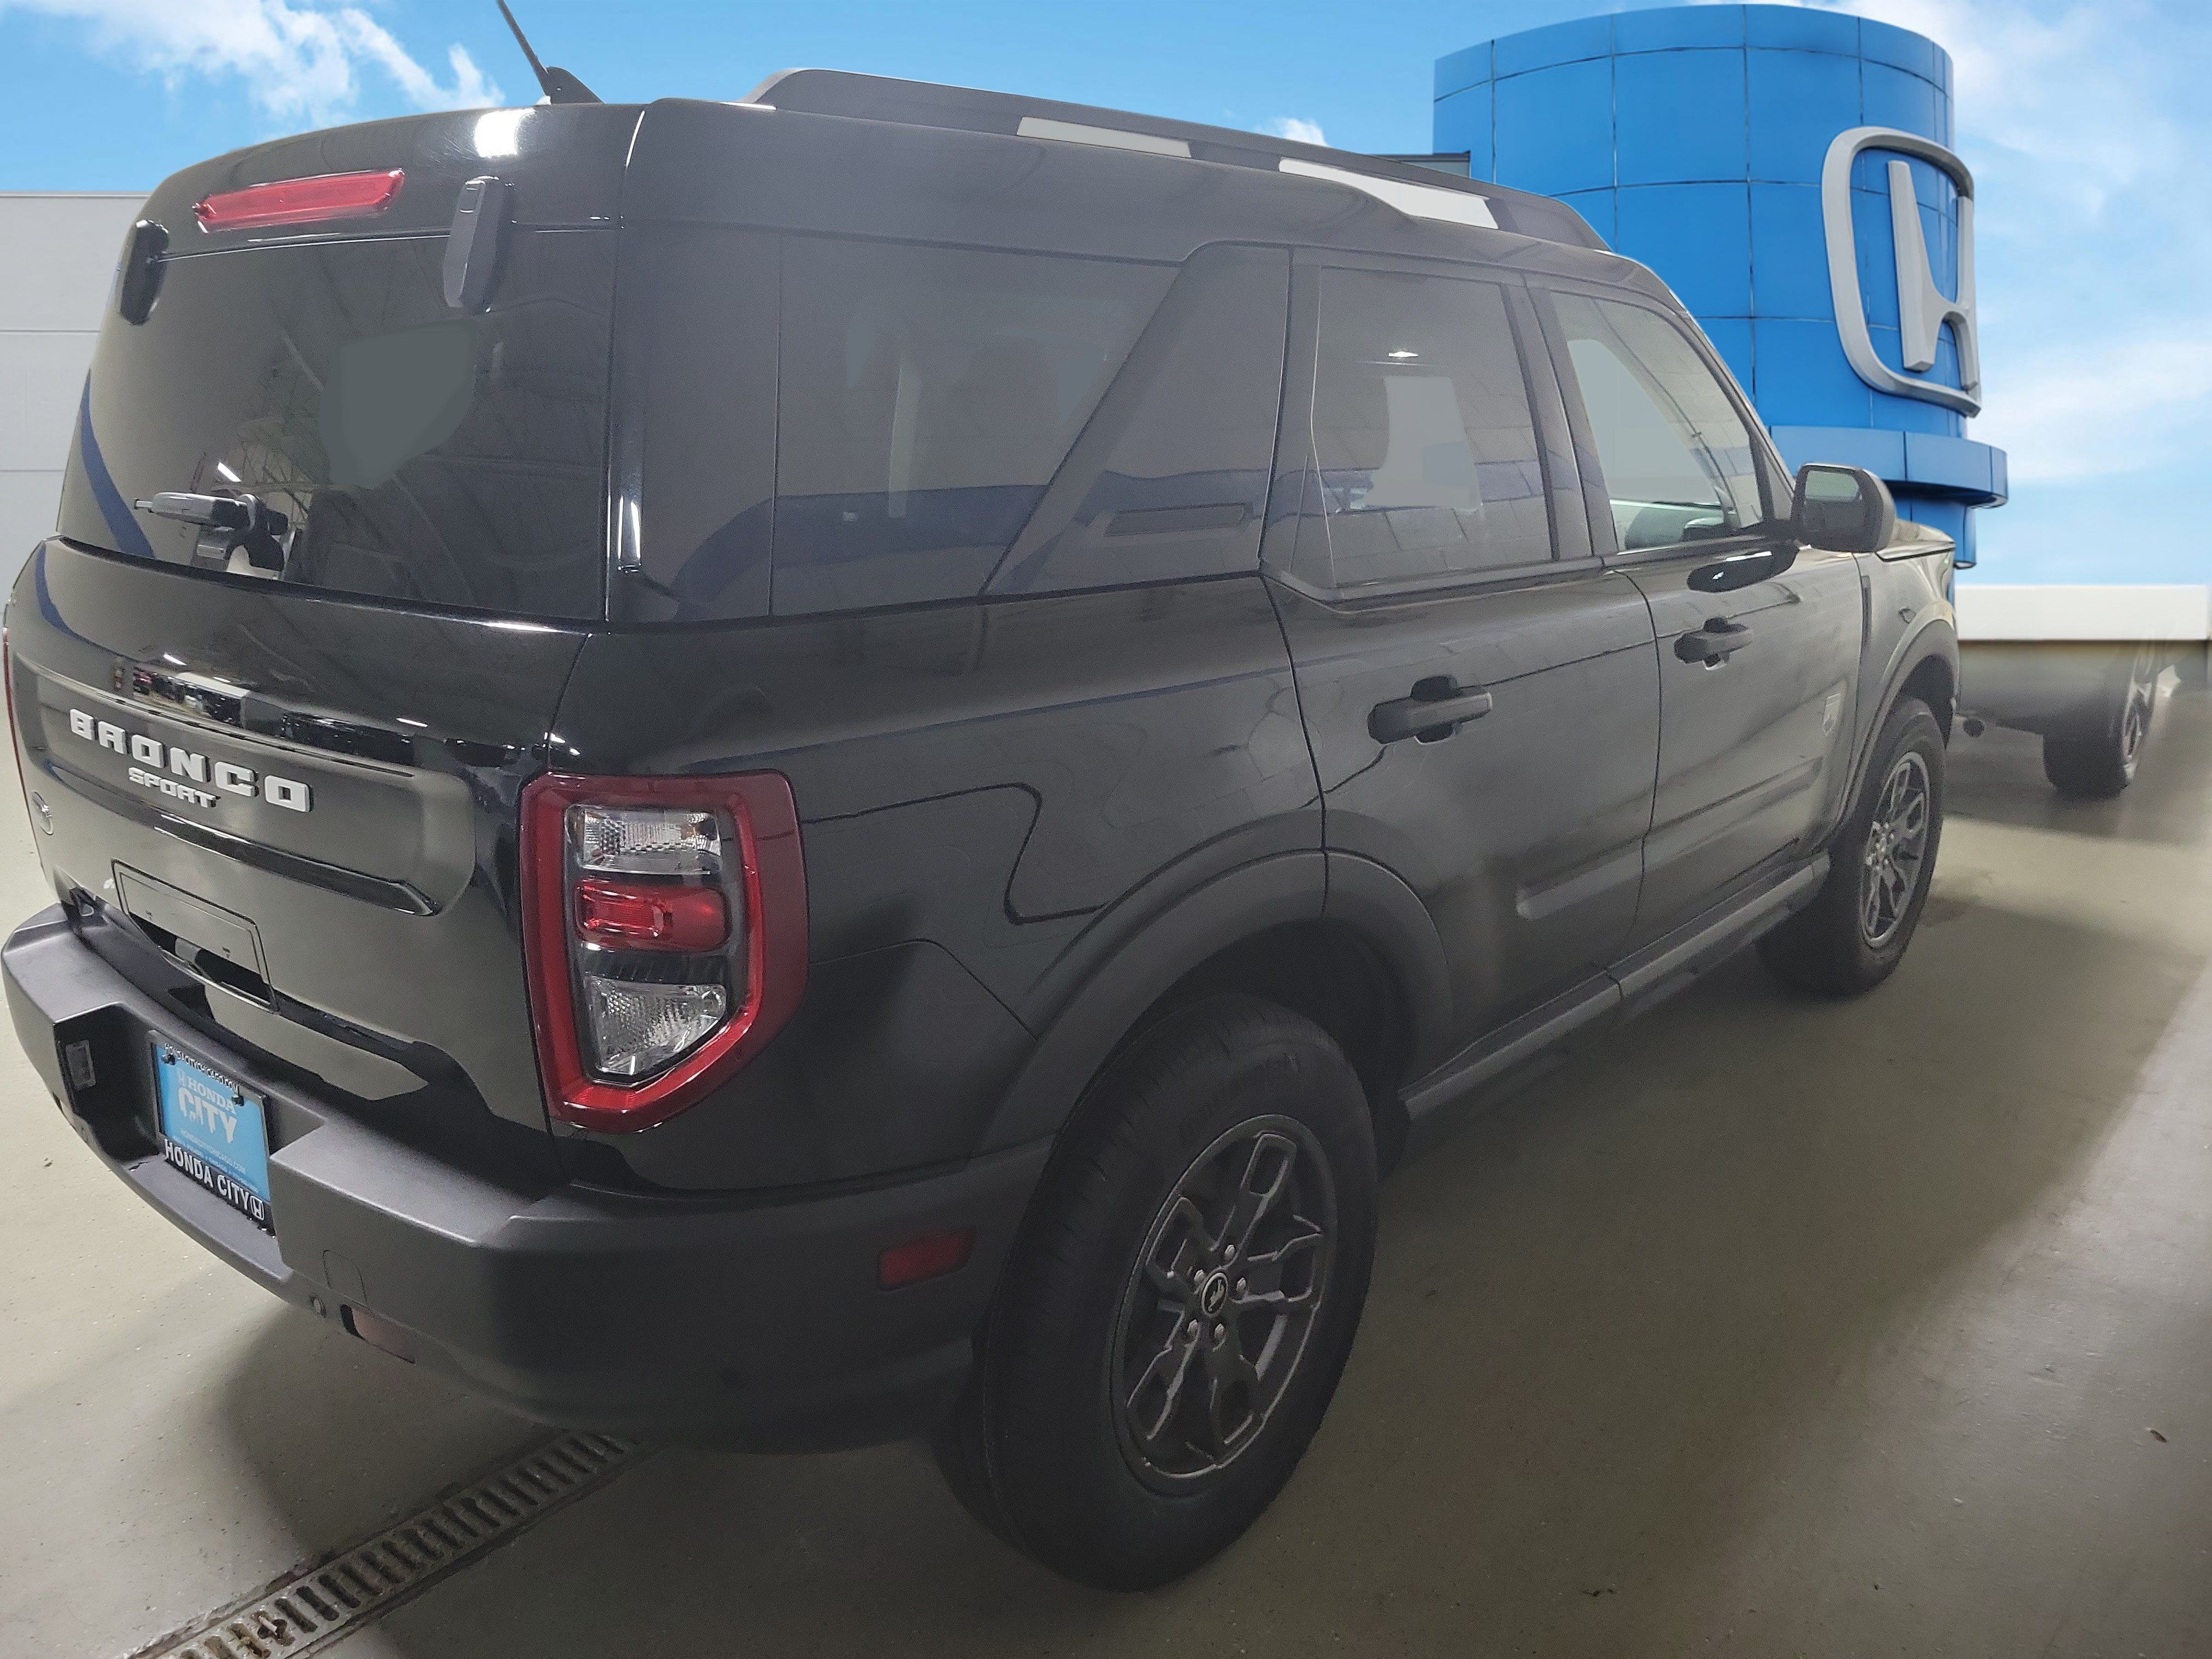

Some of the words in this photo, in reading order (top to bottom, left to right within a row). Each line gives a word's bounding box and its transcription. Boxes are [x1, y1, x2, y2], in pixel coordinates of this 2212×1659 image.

[70, 709, 312, 812] BRONCO
[128, 767, 219, 808] SPORT
[178, 1086, 237, 1144] CITY
[187, 1075, 237, 1115] HONDA
[165, 1139, 214, 1188] HONDA
[217, 1174, 251, 1211] CITY
